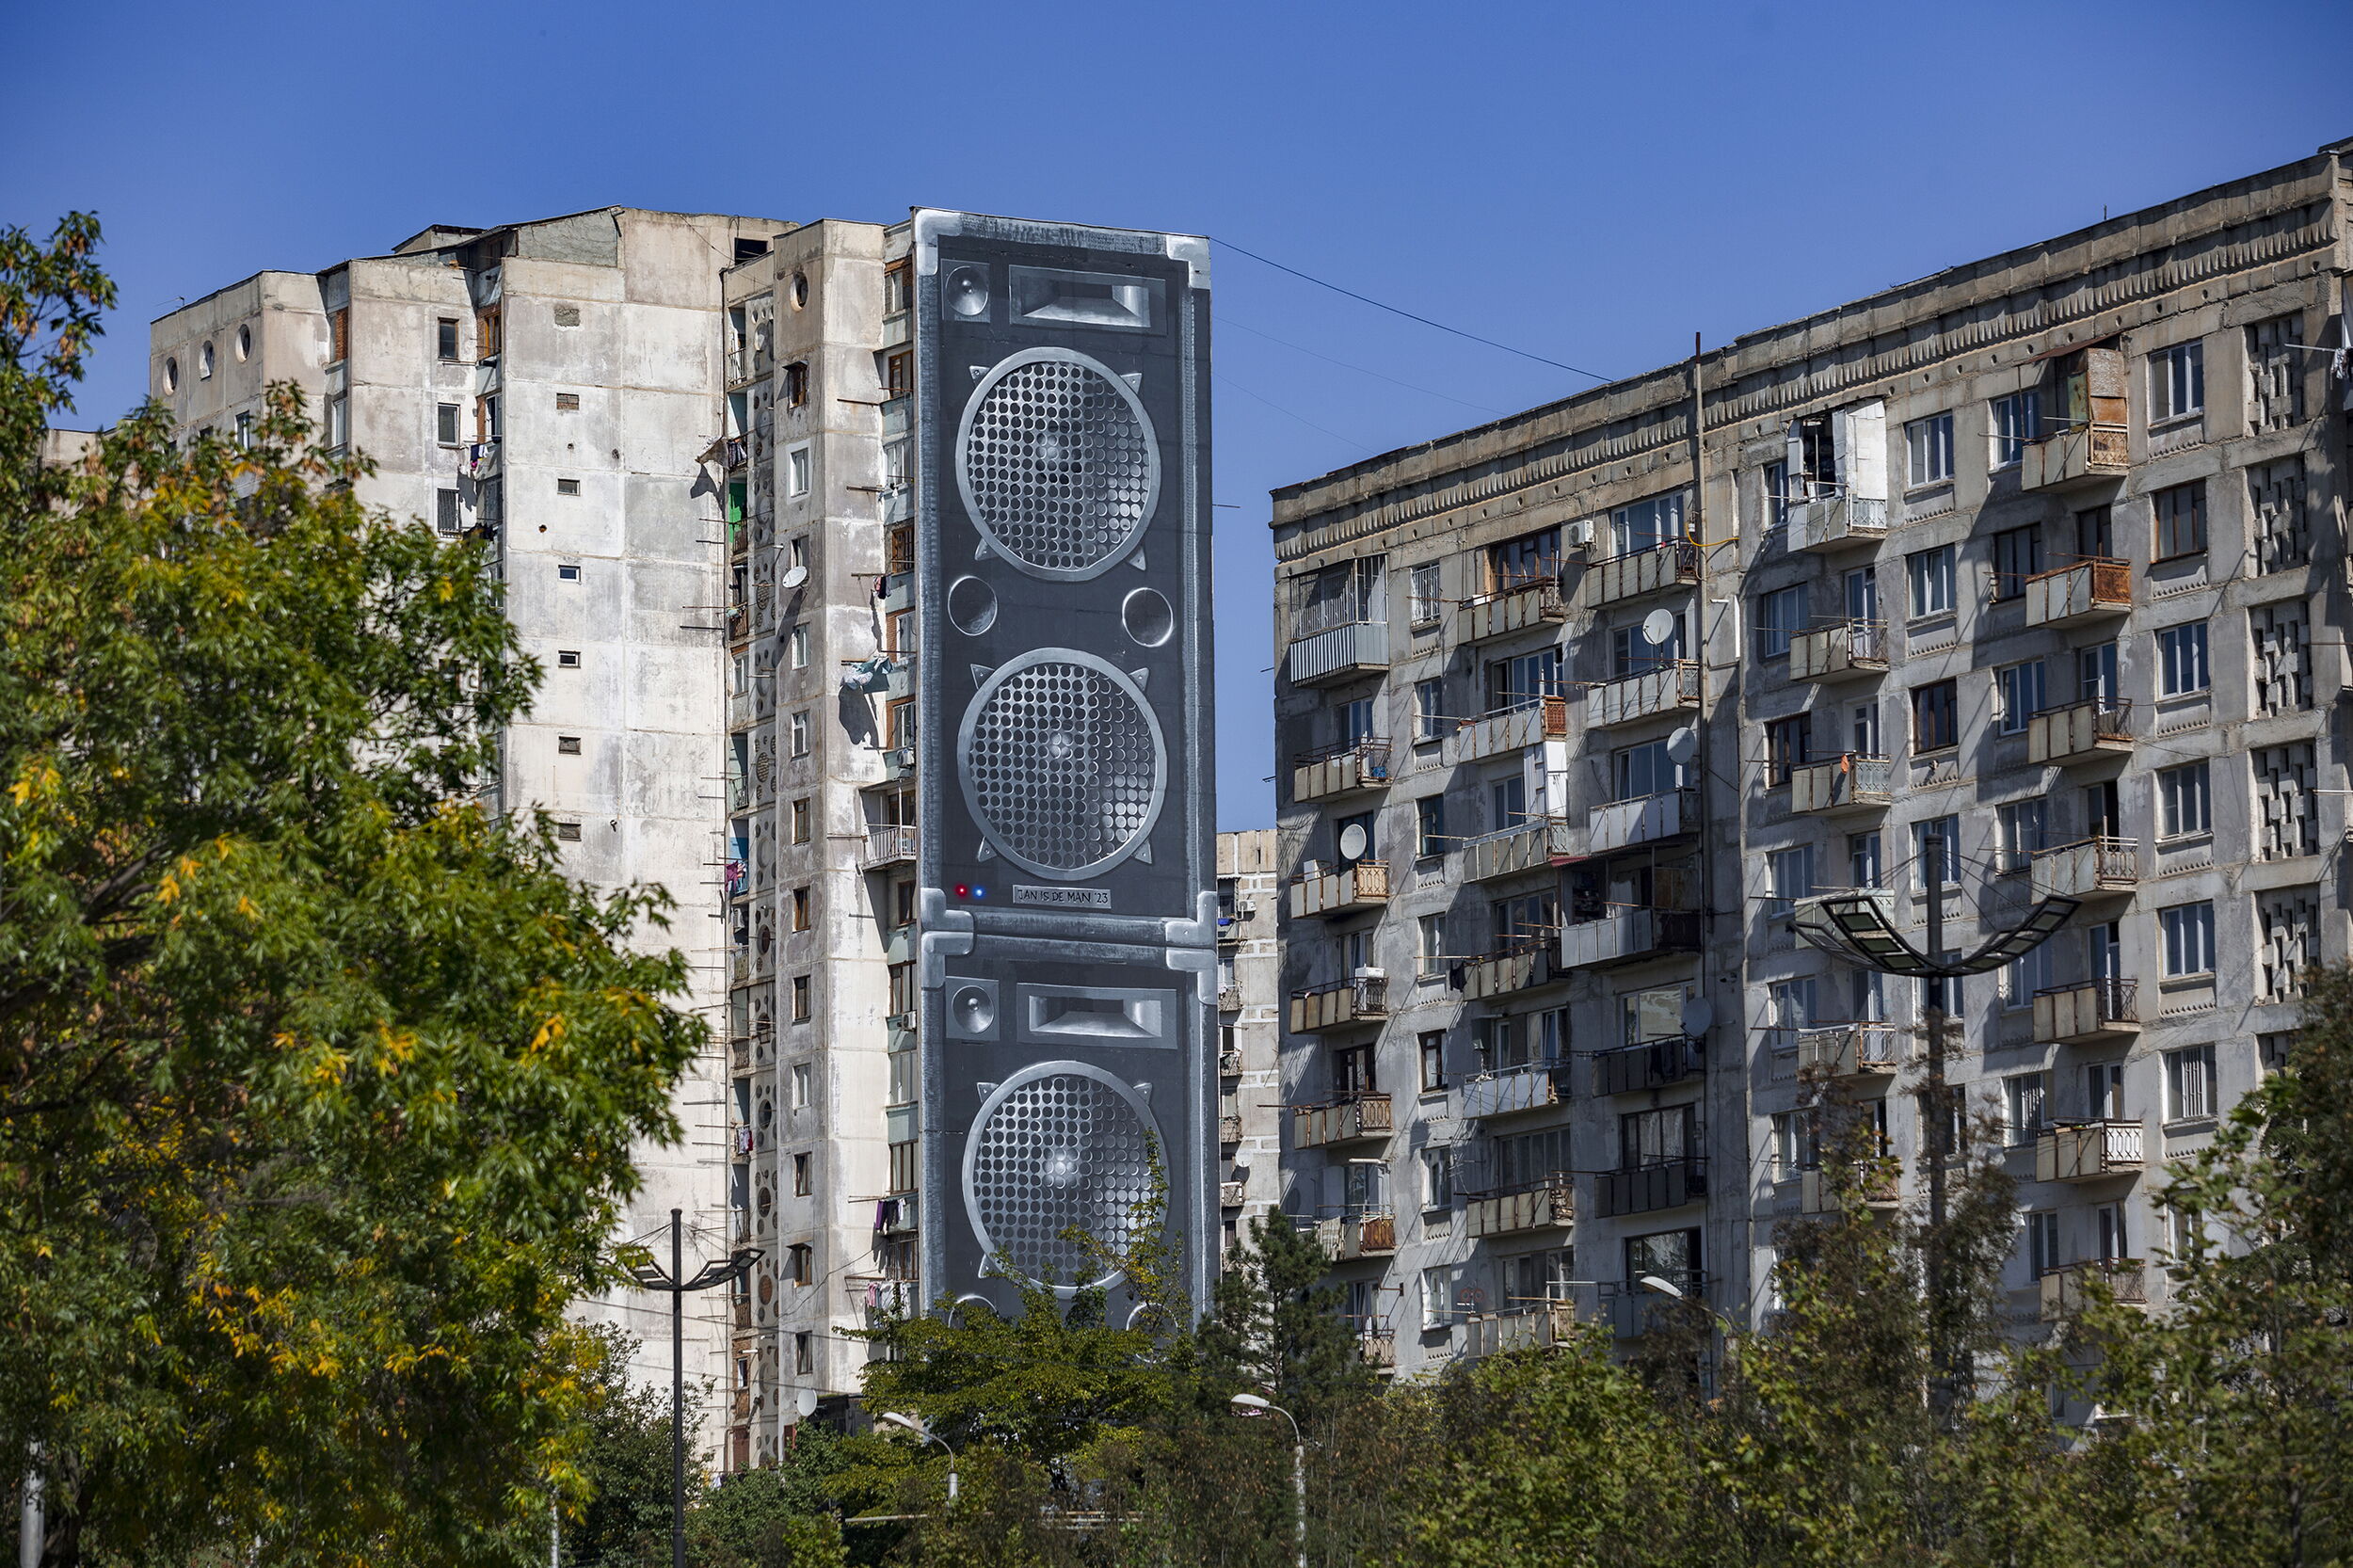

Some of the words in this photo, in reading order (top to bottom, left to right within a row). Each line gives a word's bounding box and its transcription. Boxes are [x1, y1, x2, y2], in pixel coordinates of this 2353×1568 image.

[1017, 889, 1037, 900] JAN
[1041, 890, 1049, 901] IS
[1052, 891, 1064, 902] DE
[1067, 891, 1091, 903] MAN
